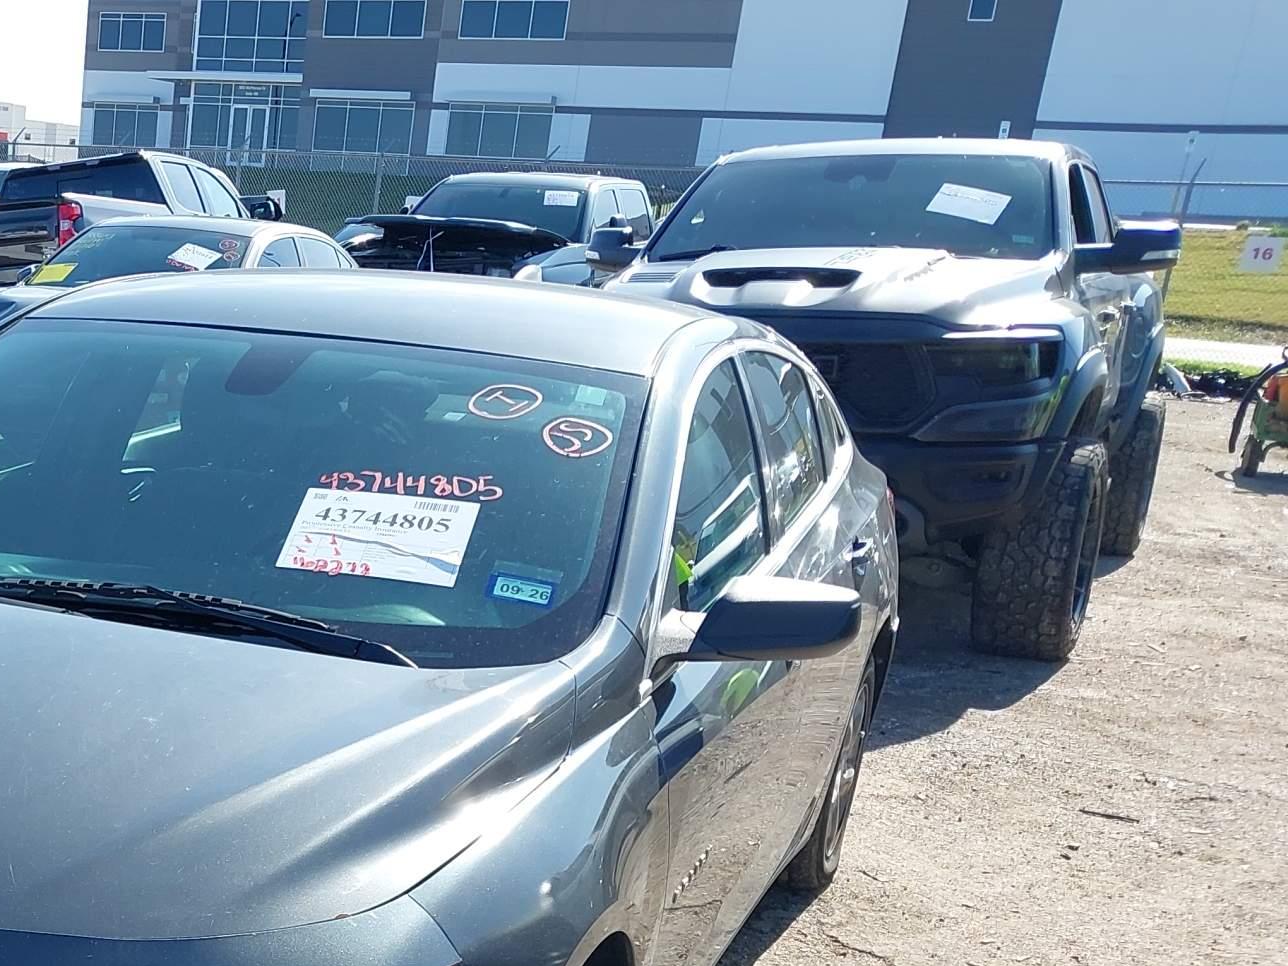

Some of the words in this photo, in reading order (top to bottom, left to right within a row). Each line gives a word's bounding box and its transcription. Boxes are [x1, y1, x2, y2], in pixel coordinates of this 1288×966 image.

[1253, 247, 1273, 260] 16
[314, 506, 453, 534] 43744805
[500, 583, 520, 595] 09
[527, 588, 550, 601] 26
